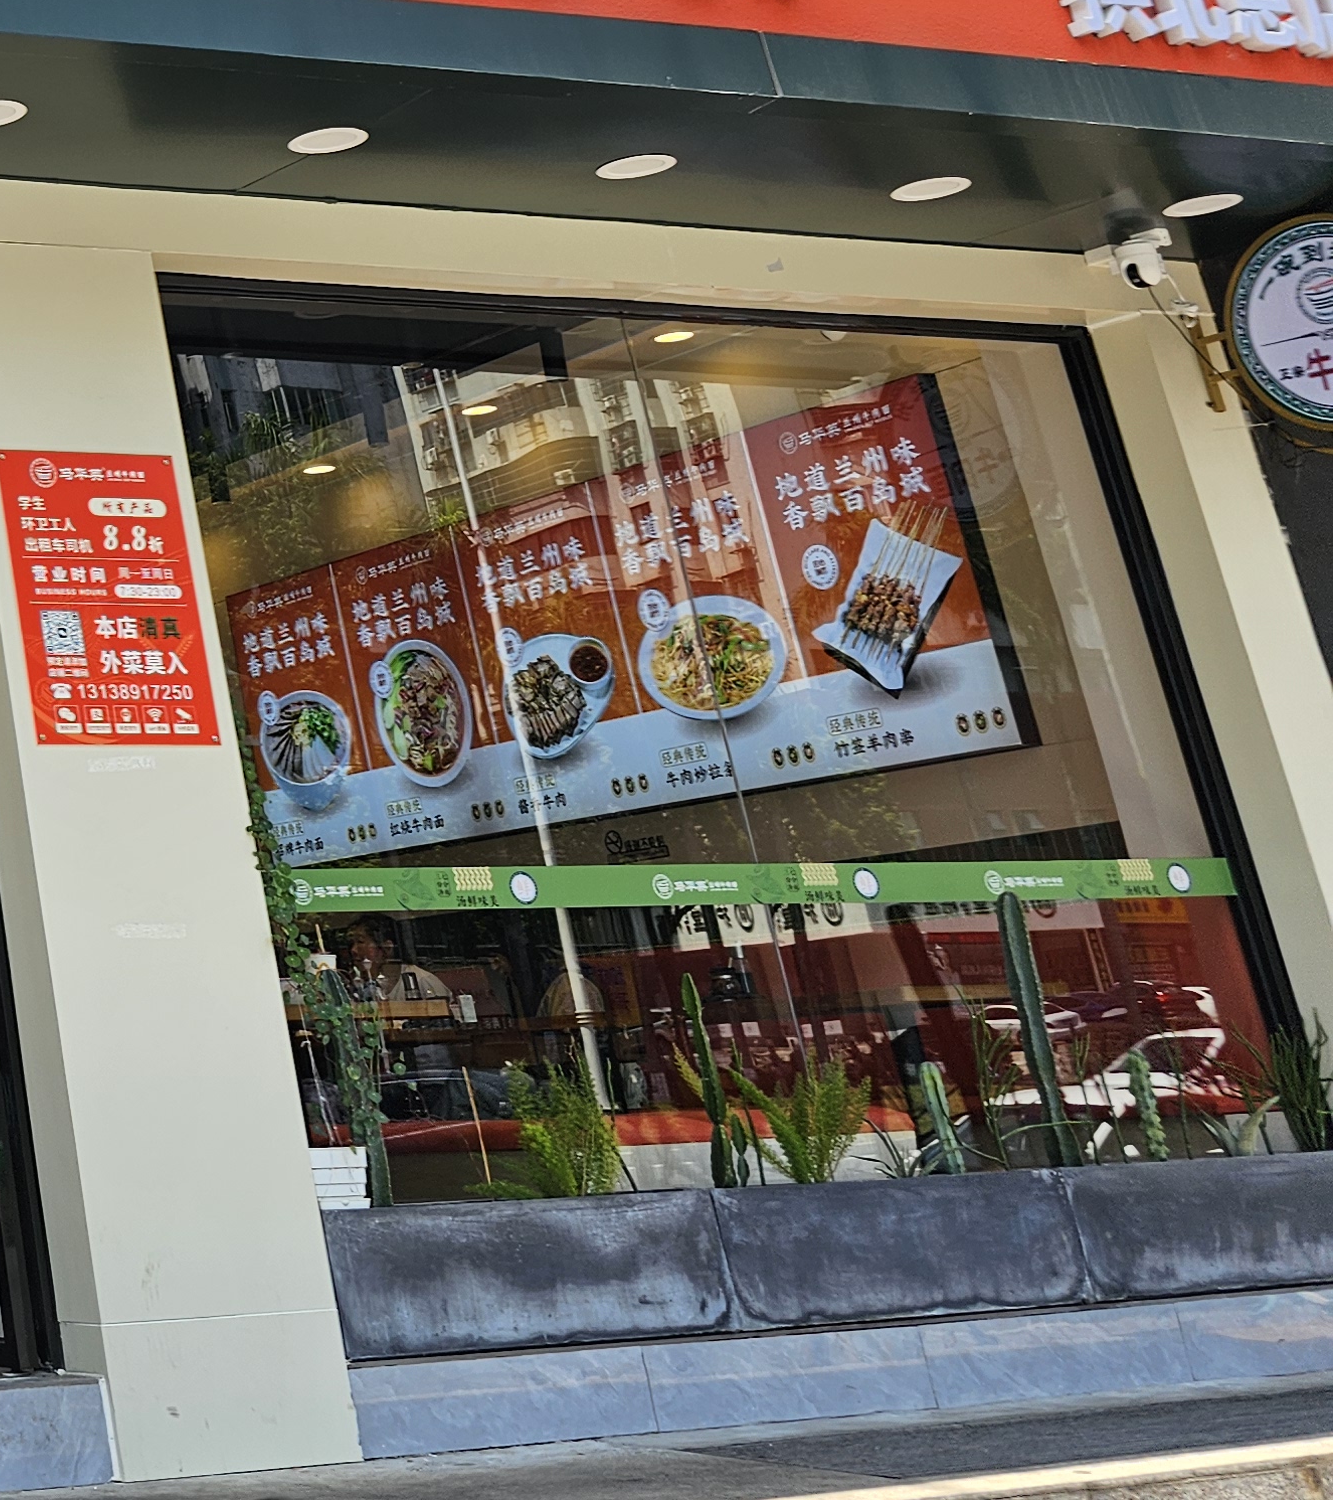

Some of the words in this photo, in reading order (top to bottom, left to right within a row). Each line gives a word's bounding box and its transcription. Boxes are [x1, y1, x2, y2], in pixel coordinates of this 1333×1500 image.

[798, 421, 841, 446] 马华英
[775, 437, 921, 500] 地道兰州味
[17, 495, 47, 510] 学生
[783, 466, 931, 530] 香飘百岛城
[21, 516, 77, 531] 环卫工人
[24, 537, 94, 553] 出租车司机
[102, 524, 164, 554] 8.8折
[31, 565, 107, 583] 营业时间
[118, 566, 174, 580] 周一至周日
[351, 575, 449, 622] 地道兰州味
[94, 615, 181, 639] 本店清真
[243, 611, 330, 653] 地道兰州味
[357, 601, 455, 648] 香飘百岛城
[100, 650, 189, 675] 外菜莫入
[77, 684, 194, 700] 13138917250
[829, 710, 882, 734] 经典传统
[390, 815, 445, 837] 红烧牛肉面
